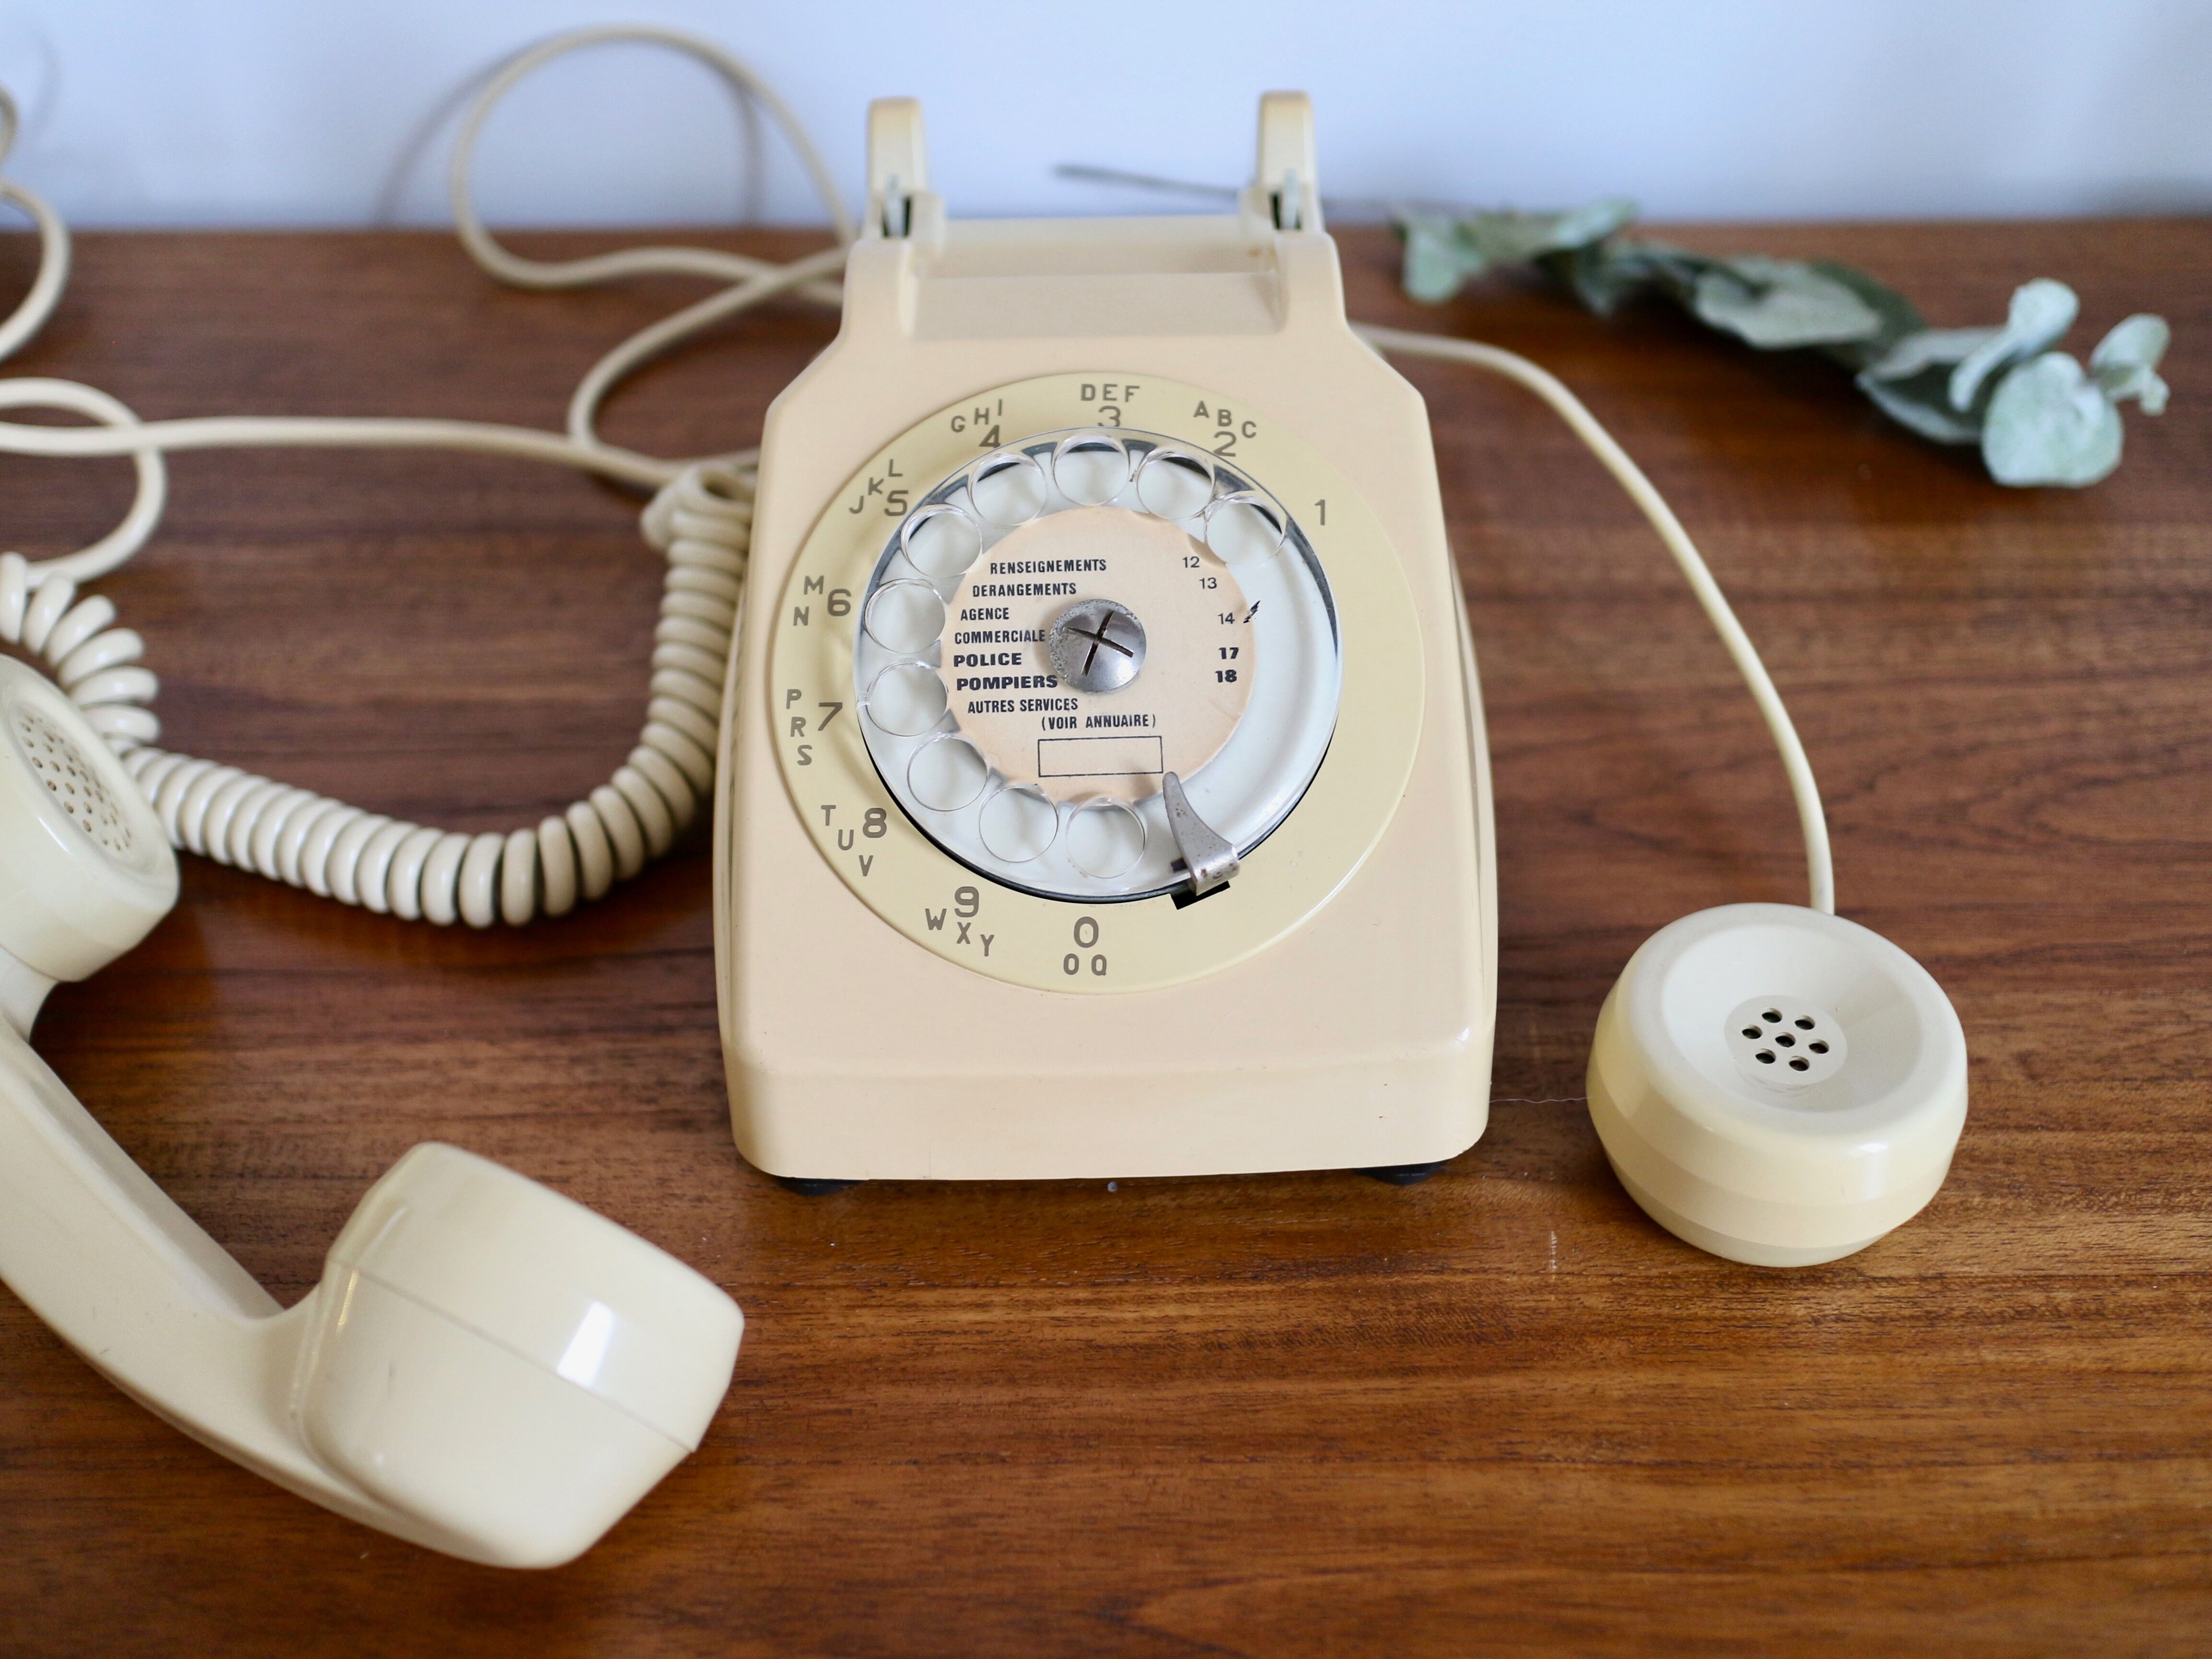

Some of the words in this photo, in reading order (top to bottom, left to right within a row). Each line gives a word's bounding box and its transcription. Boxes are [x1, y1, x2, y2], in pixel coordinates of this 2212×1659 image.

[1098, 405, 1120, 427] 3
[979, 425, 1001, 449] 4
[1213, 431, 1236, 457] 2
[884, 490, 909, 517] 5
[1314, 499, 1326, 526] 1
[990, 559, 1106, 575] RENSEIGNEMENTS
[1182, 556, 1200, 568] 12
[973, 582, 1077, 598] DERANGEMENTS
[1199, 577, 1217, 590] 13
[827, 589, 851, 616] 6
[960, 608, 1010, 621] AGENCE
[1218, 613, 1235, 625] 14
[954, 630, 1046, 644] COMMERCIALE
[953, 652, 1022, 667] POLICE
[1218, 647, 1239, 660] 17
[956, 674, 1058, 691] POMPIERS
[1215, 670, 1238, 683] 18
[817, 702, 842, 731] 7
[968, 699, 1015, 714] AUTRES
[1019, 697, 1078, 712] SERVICES
[1042, 717, 1077, 731] (VOIR
[1085, 713, 1156, 728] ANNUAIRE)
[862, 807, 887, 838] 8
[954, 886, 979, 917] 9
[1074, 916, 1099, 948] 0
